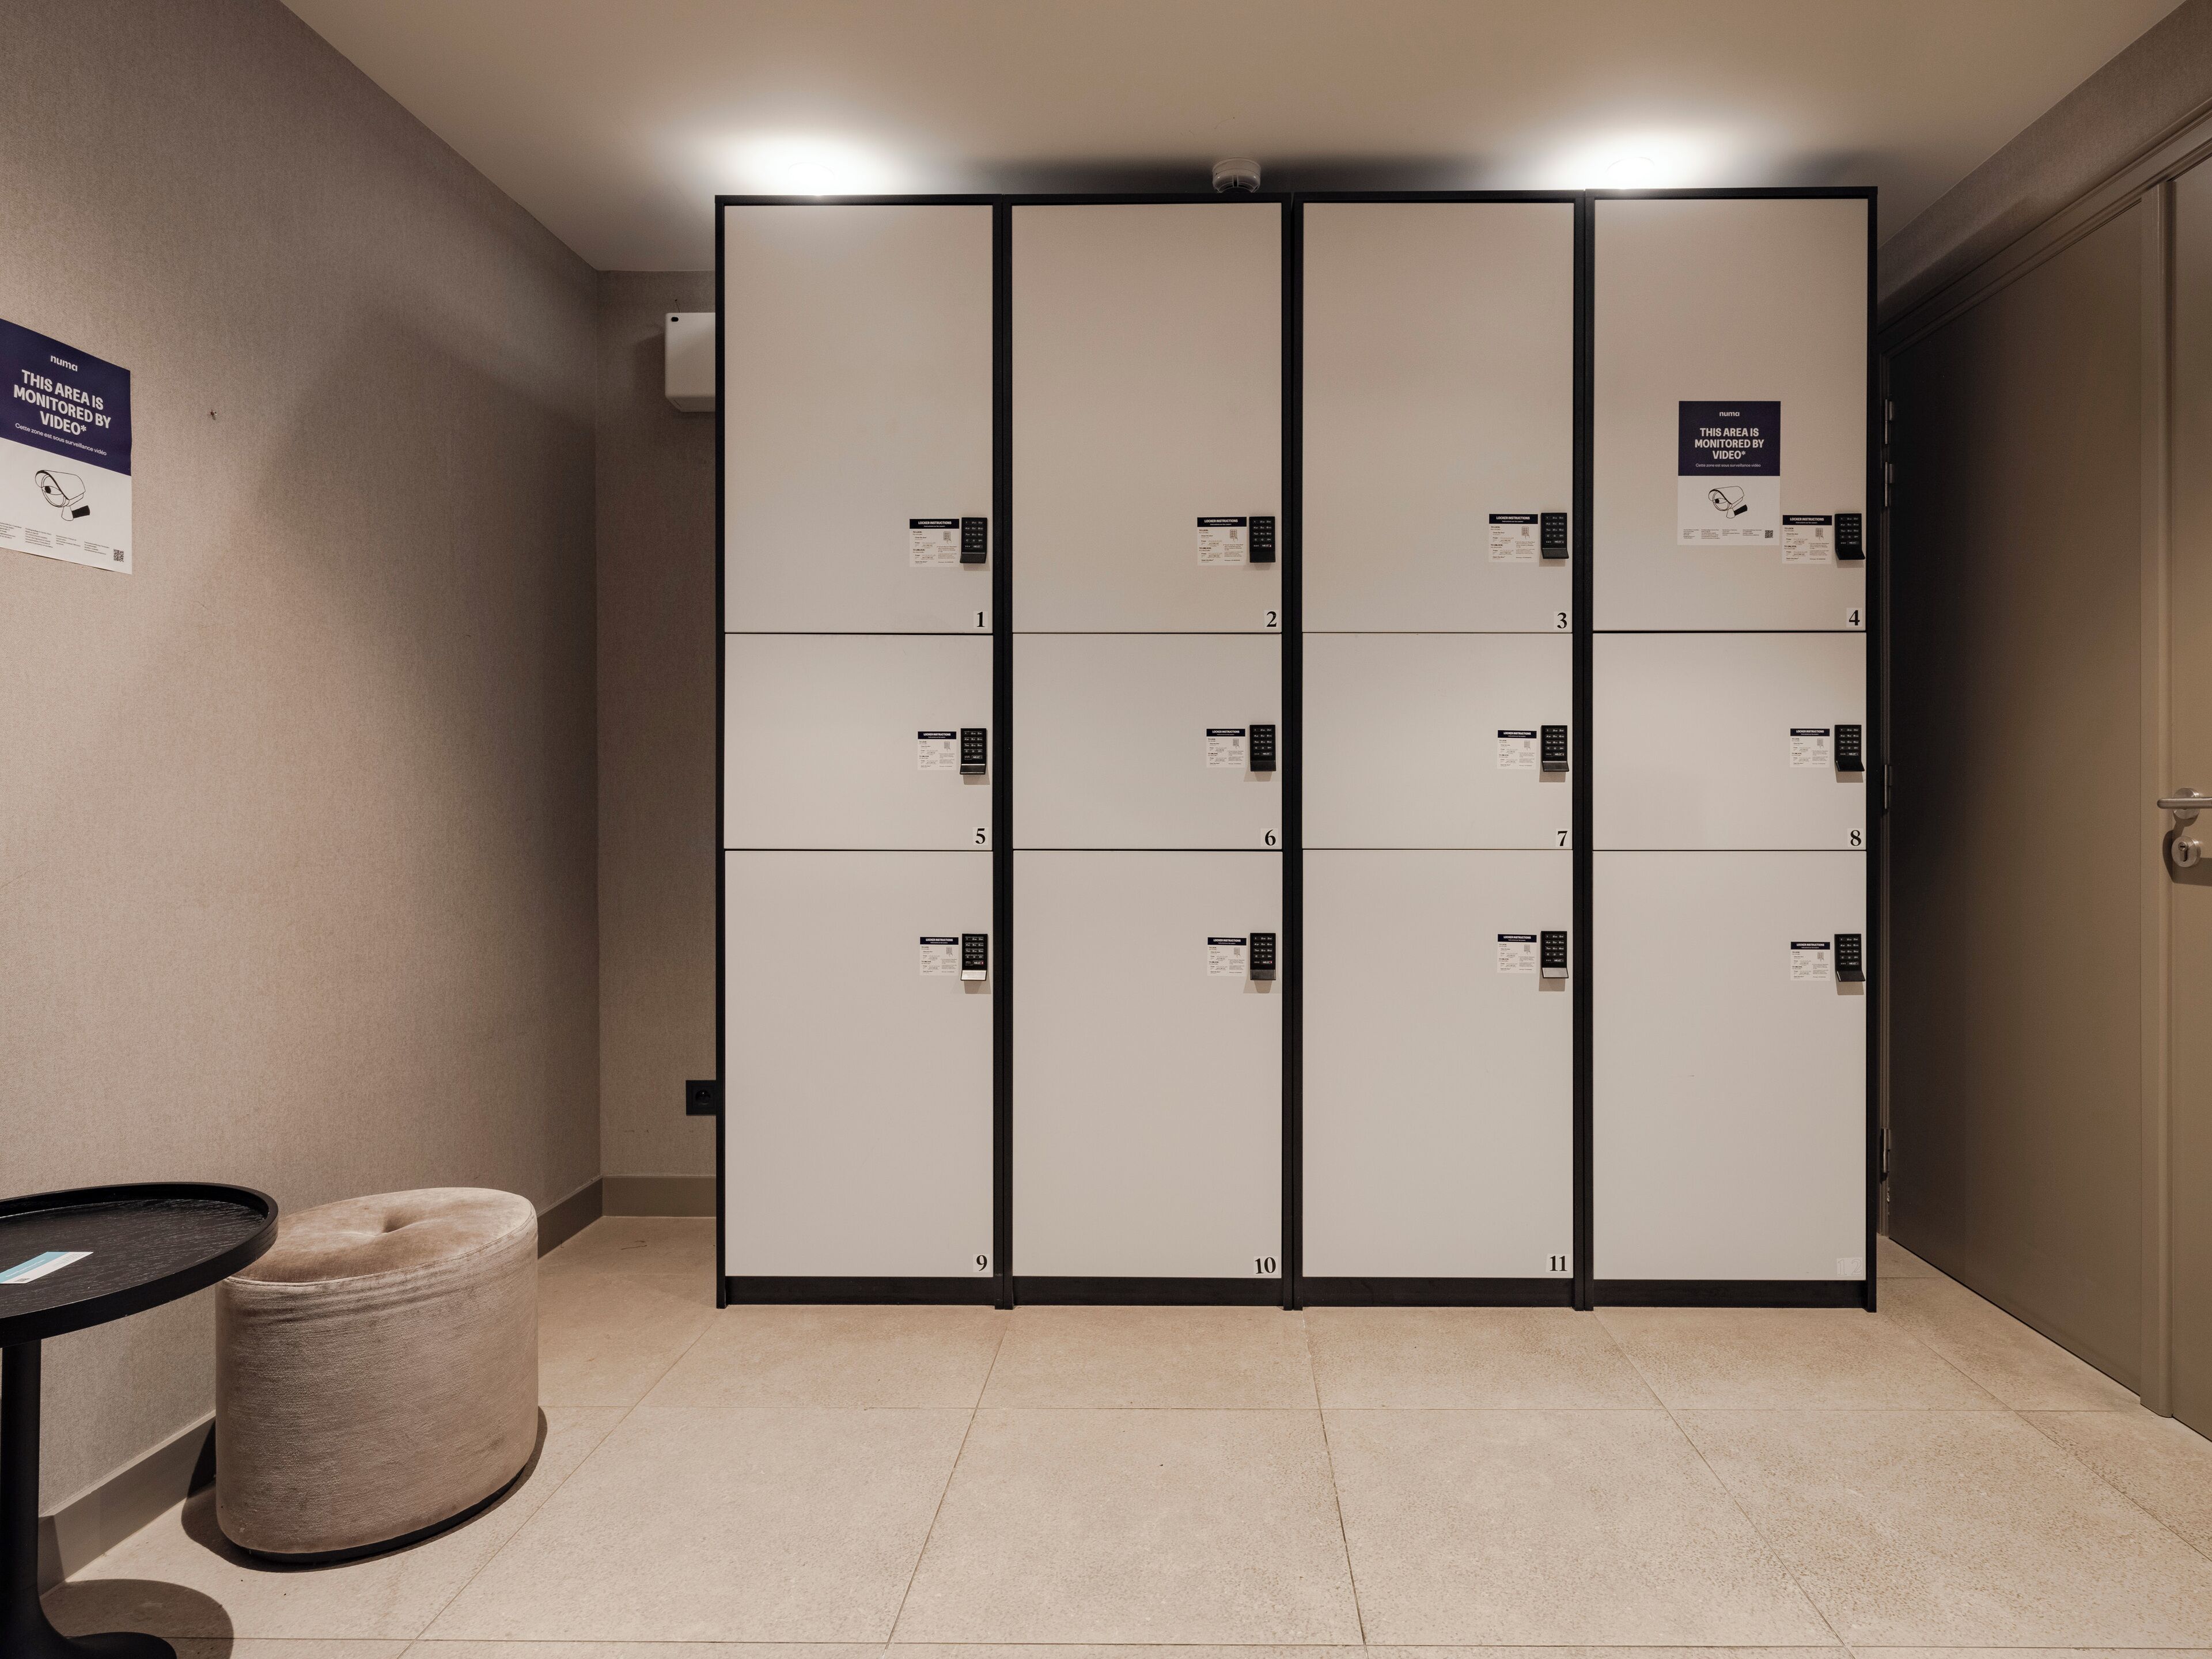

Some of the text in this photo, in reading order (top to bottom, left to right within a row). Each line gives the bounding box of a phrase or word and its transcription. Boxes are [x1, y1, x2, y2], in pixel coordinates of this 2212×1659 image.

[50, 355, 78, 372] numa
[22, 369, 104, 410] THIS AREA IS
[14, 384, 111, 429] MONITORED BY
[16, 423, 30, 432] Cette
[65, 440, 93, 452] surveillance
[1700, 428, 1759, 437] THIS AREA IS
[1695, 440, 1764, 448] MONITORED BY
[976, 611, 984, 627] 1
[1266, 611, 1277, 627] 2
[1556, 612, 1567, 629] 3
[1849, 609, 1861, 626] 4
[975, 828, 986, 844] 5
[1264, 829, 1276, 846] 6
[1557, 831, 1568, 847] 7
[1850, 830, 1862, 846] 8
[976, 1255, 987, 1271] 9
[1255, 1257, 1277, 1274] 10
[1550, 1255, 1567, 1271] 11
